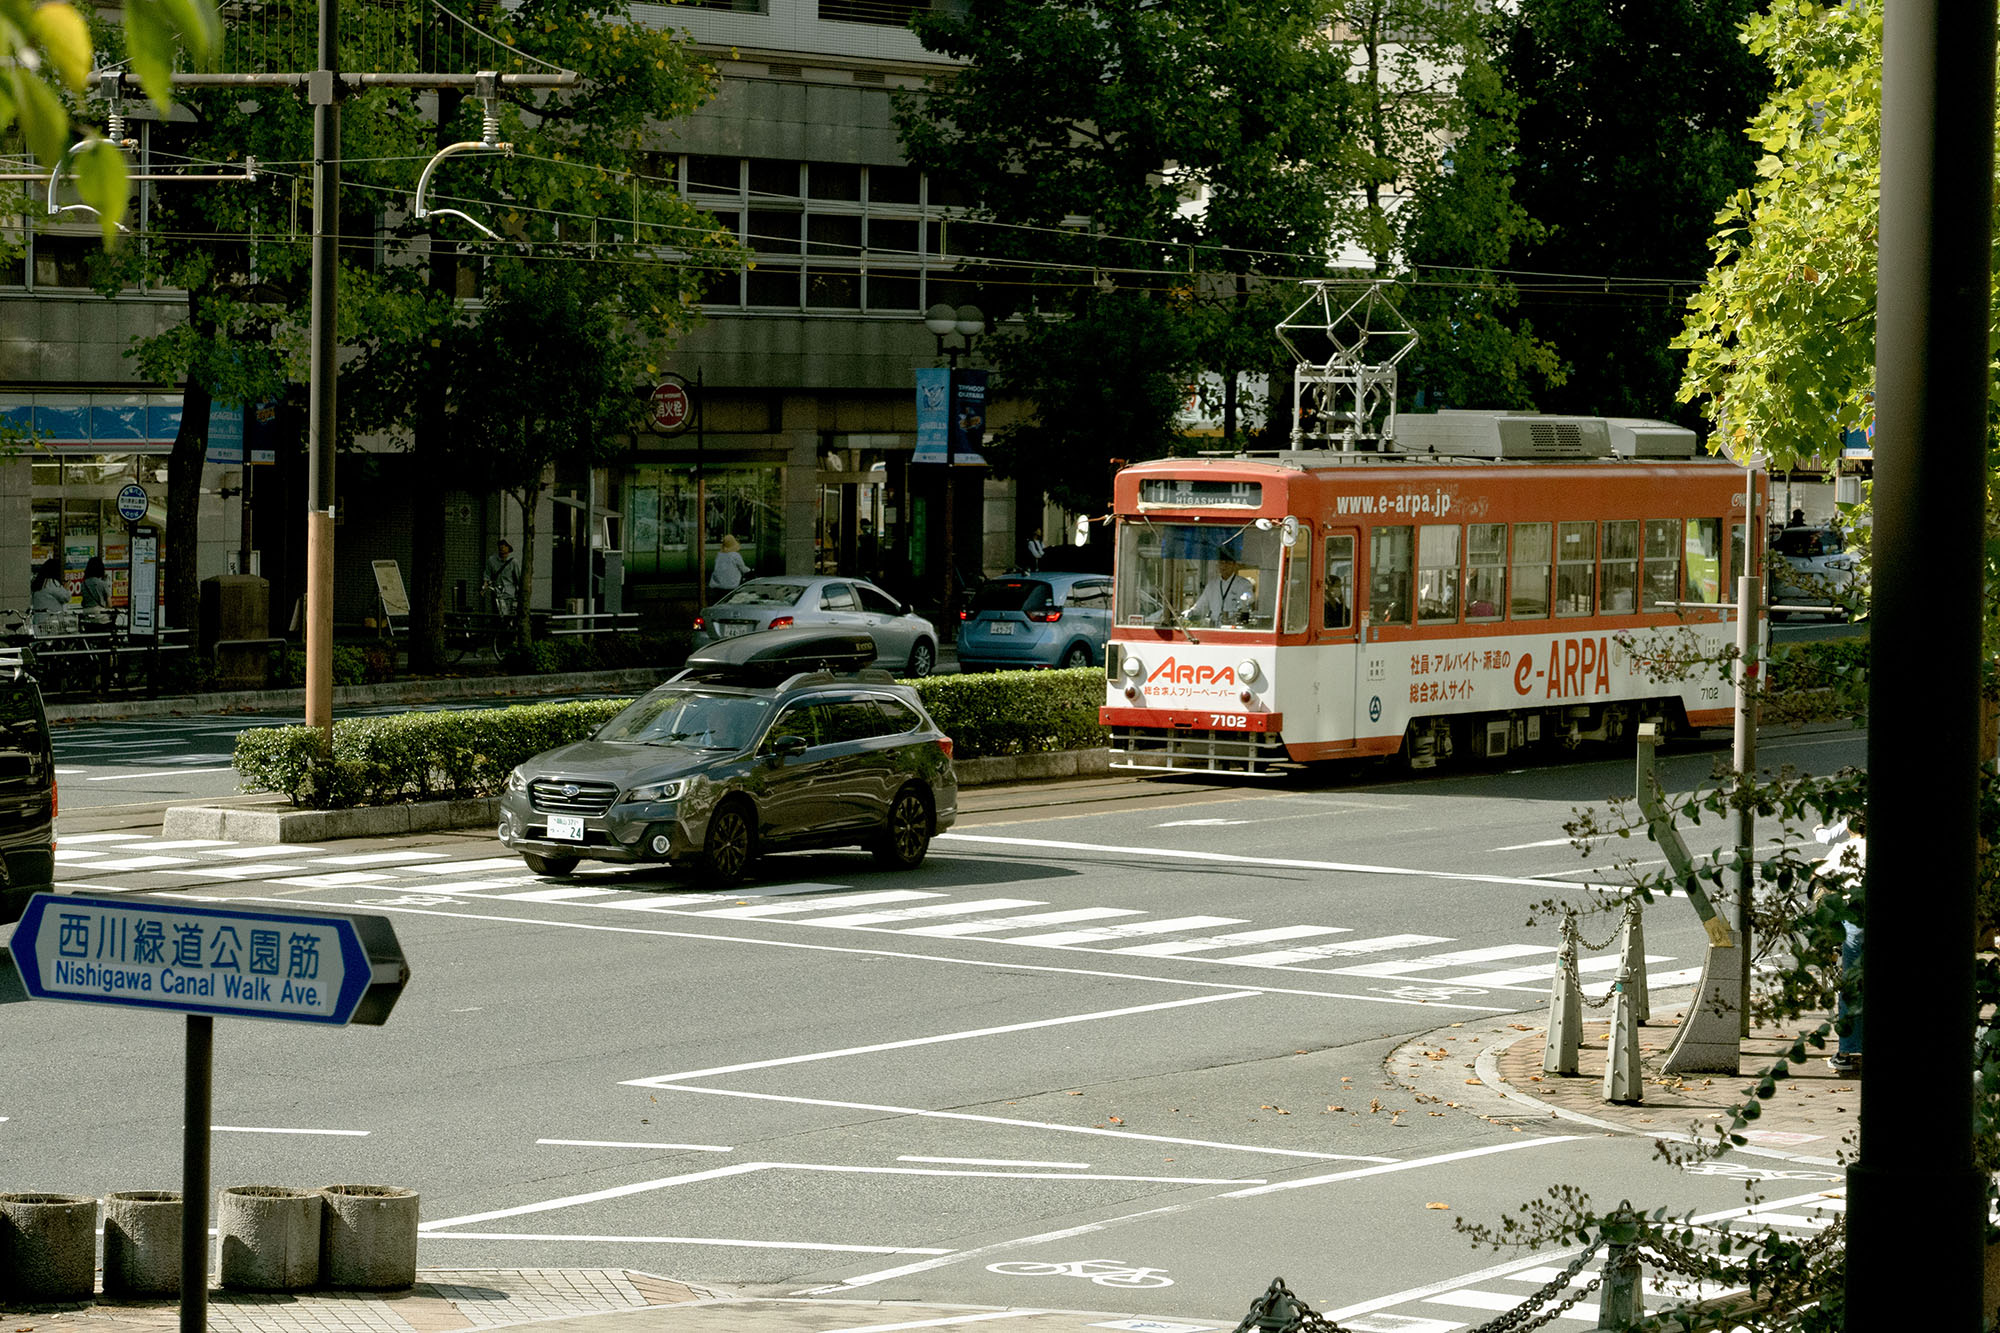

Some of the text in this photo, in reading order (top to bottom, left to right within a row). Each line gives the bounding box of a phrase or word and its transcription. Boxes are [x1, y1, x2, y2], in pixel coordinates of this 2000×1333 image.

[655, 400, 683, 418] 消火栓
[1156, 482, 1165, 502] 1
[1175, 497, 1249, 506] HIGASHIYAMA
[1337, 489, 1451, 518] www.e-arpa.jp
[1513, 636, 1611, 699] e-ARPA
[1409, 679, 1474, 704] 総合求人サイト
[1701, 687, 1719, 700] 7102
[1210, 714, 1247, 728] 7102
[58, 912, 321, 980] 西川緑道公園筋
[55, 960, 322, 1007] Nishigawa Canal Walk Ave.
